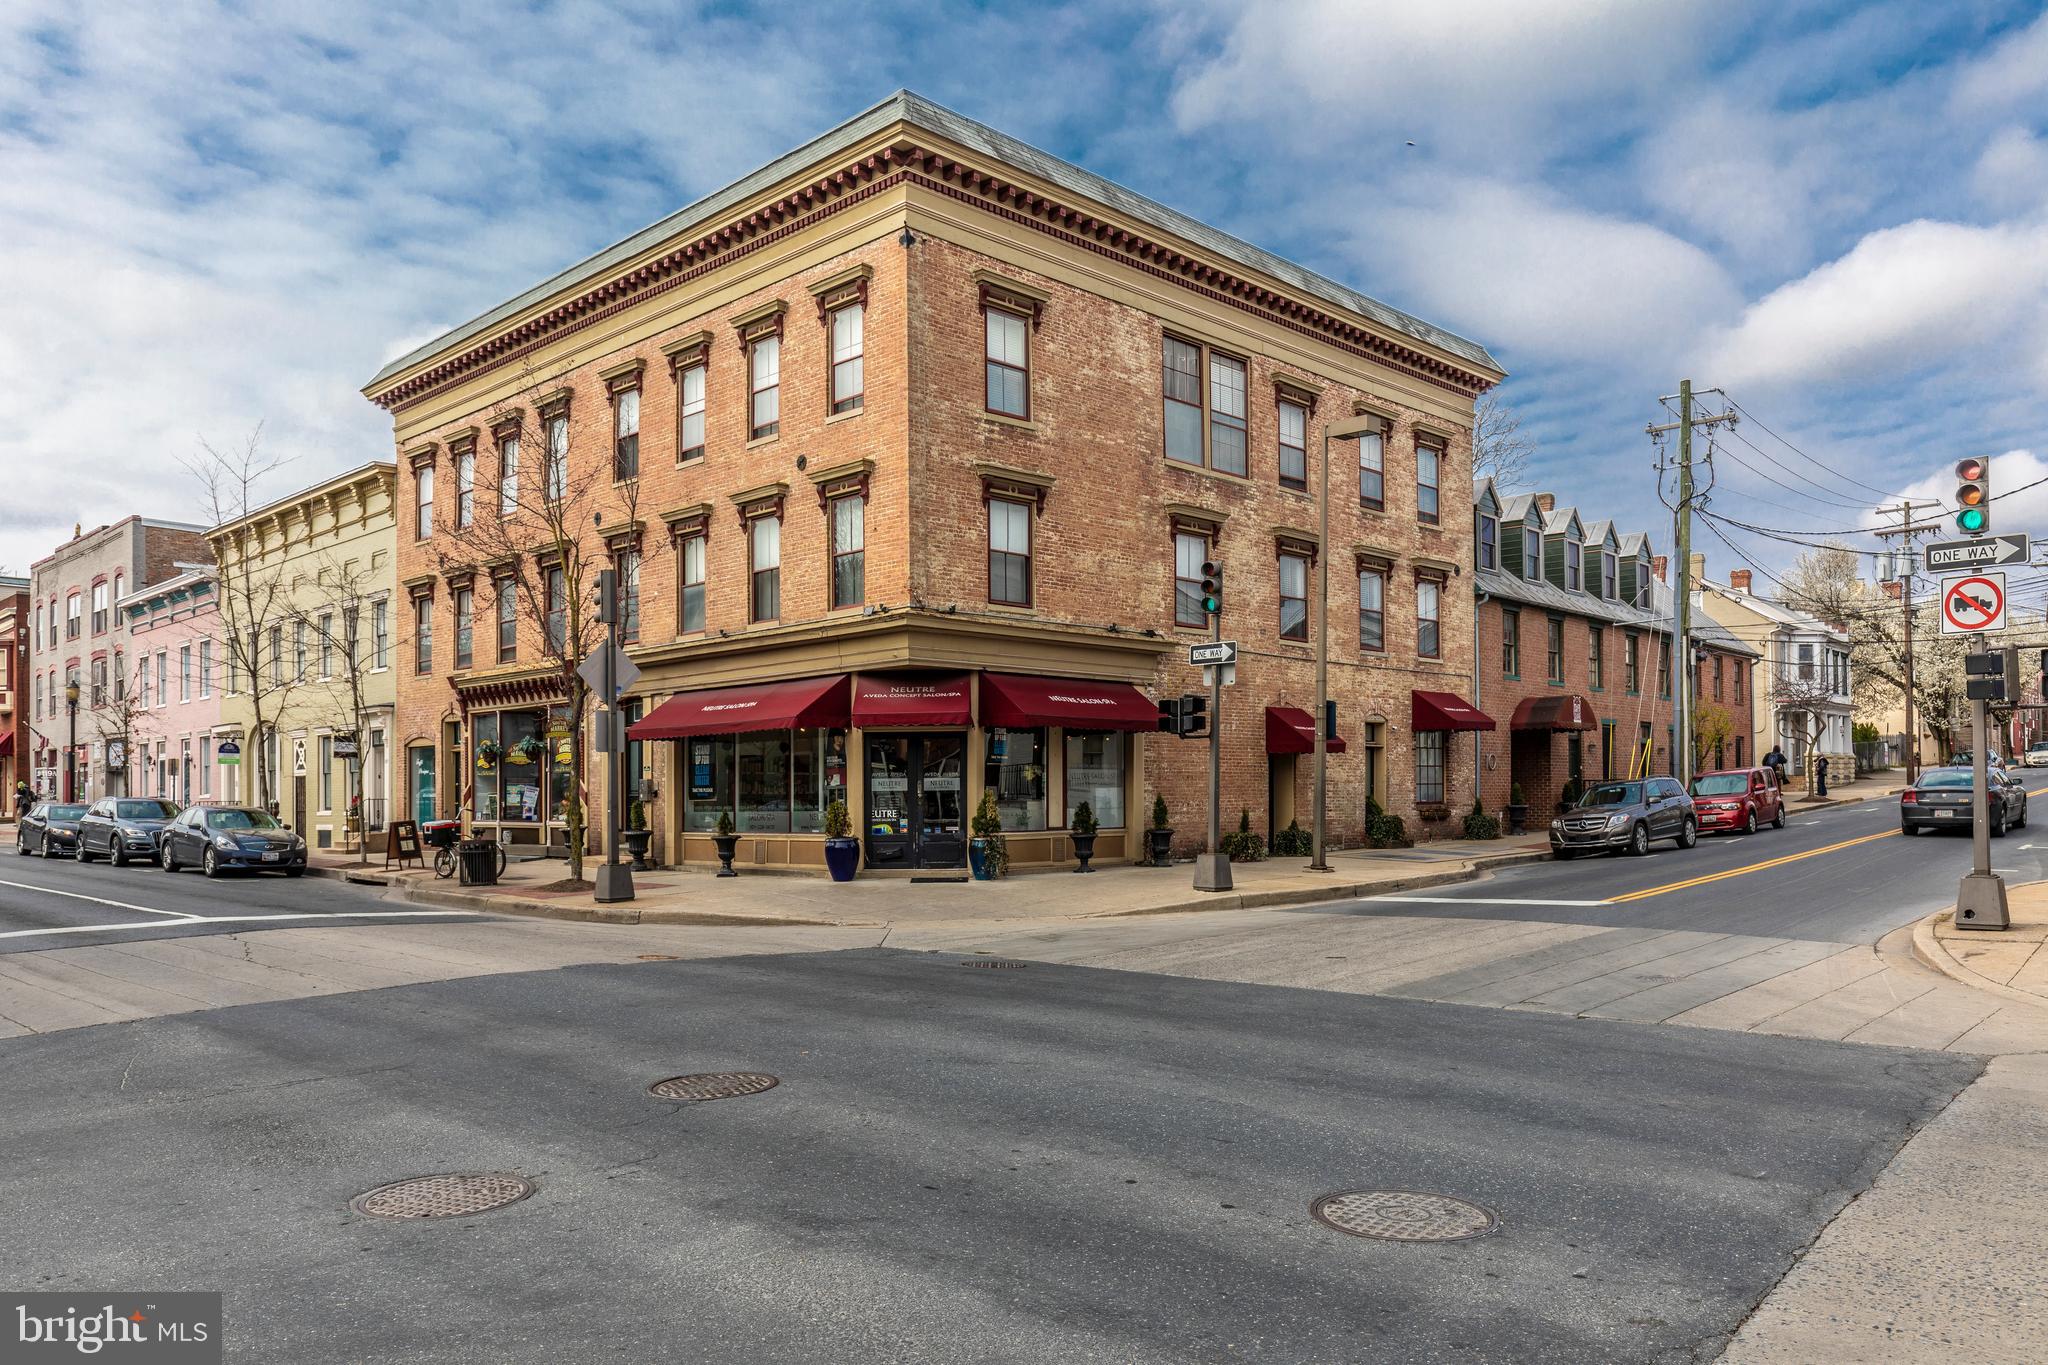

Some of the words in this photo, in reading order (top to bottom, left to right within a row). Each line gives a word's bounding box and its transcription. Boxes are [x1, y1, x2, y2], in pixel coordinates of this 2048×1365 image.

[1932, 549, 1961, 563] ONE
[1967, 545, 1998, 559] WAY
[1194, 650, 1207, 659] ONE
[1209, 648, 1223, 658] WAY
